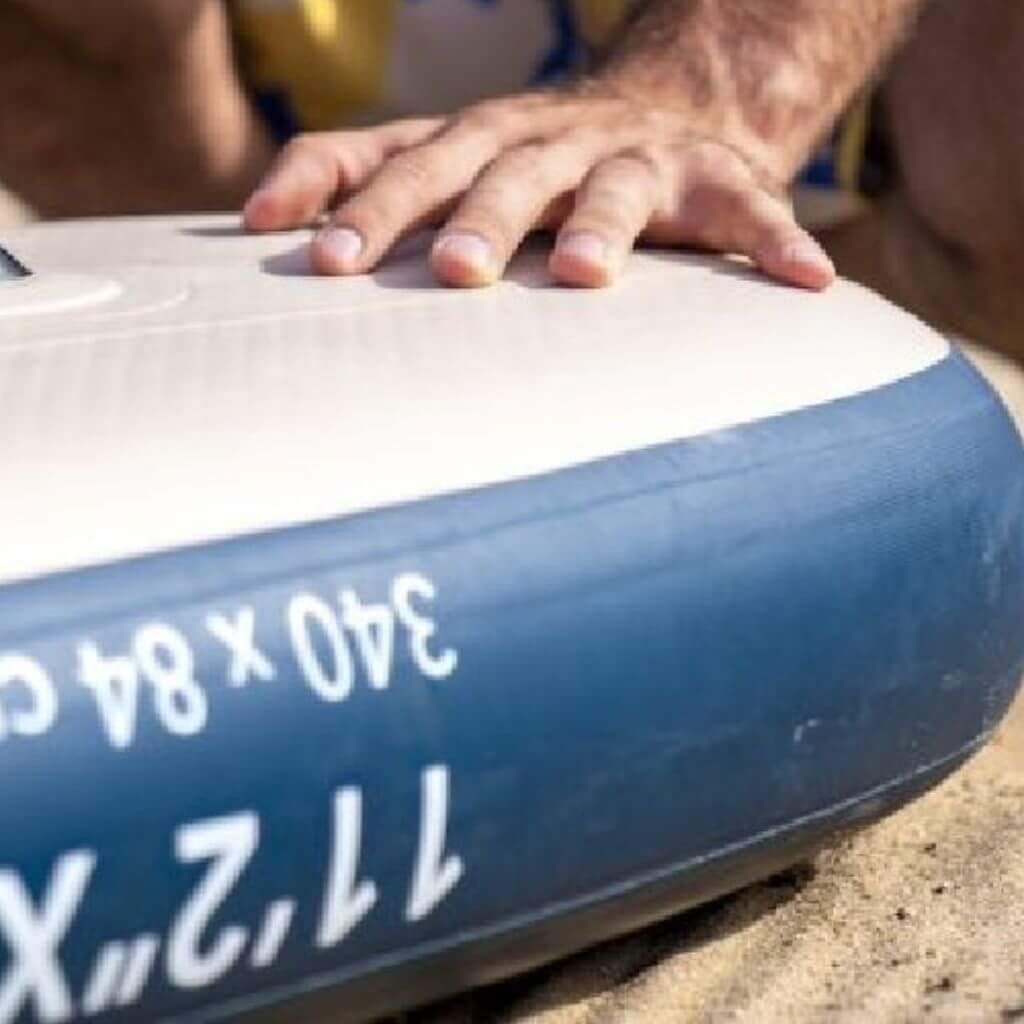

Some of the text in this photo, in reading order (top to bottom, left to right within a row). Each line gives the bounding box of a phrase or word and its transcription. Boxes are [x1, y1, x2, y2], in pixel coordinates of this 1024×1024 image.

[77, 622, 208, 749] 84
[207, 604, 275, 687] x
[288, 571, 459, 703] 340
